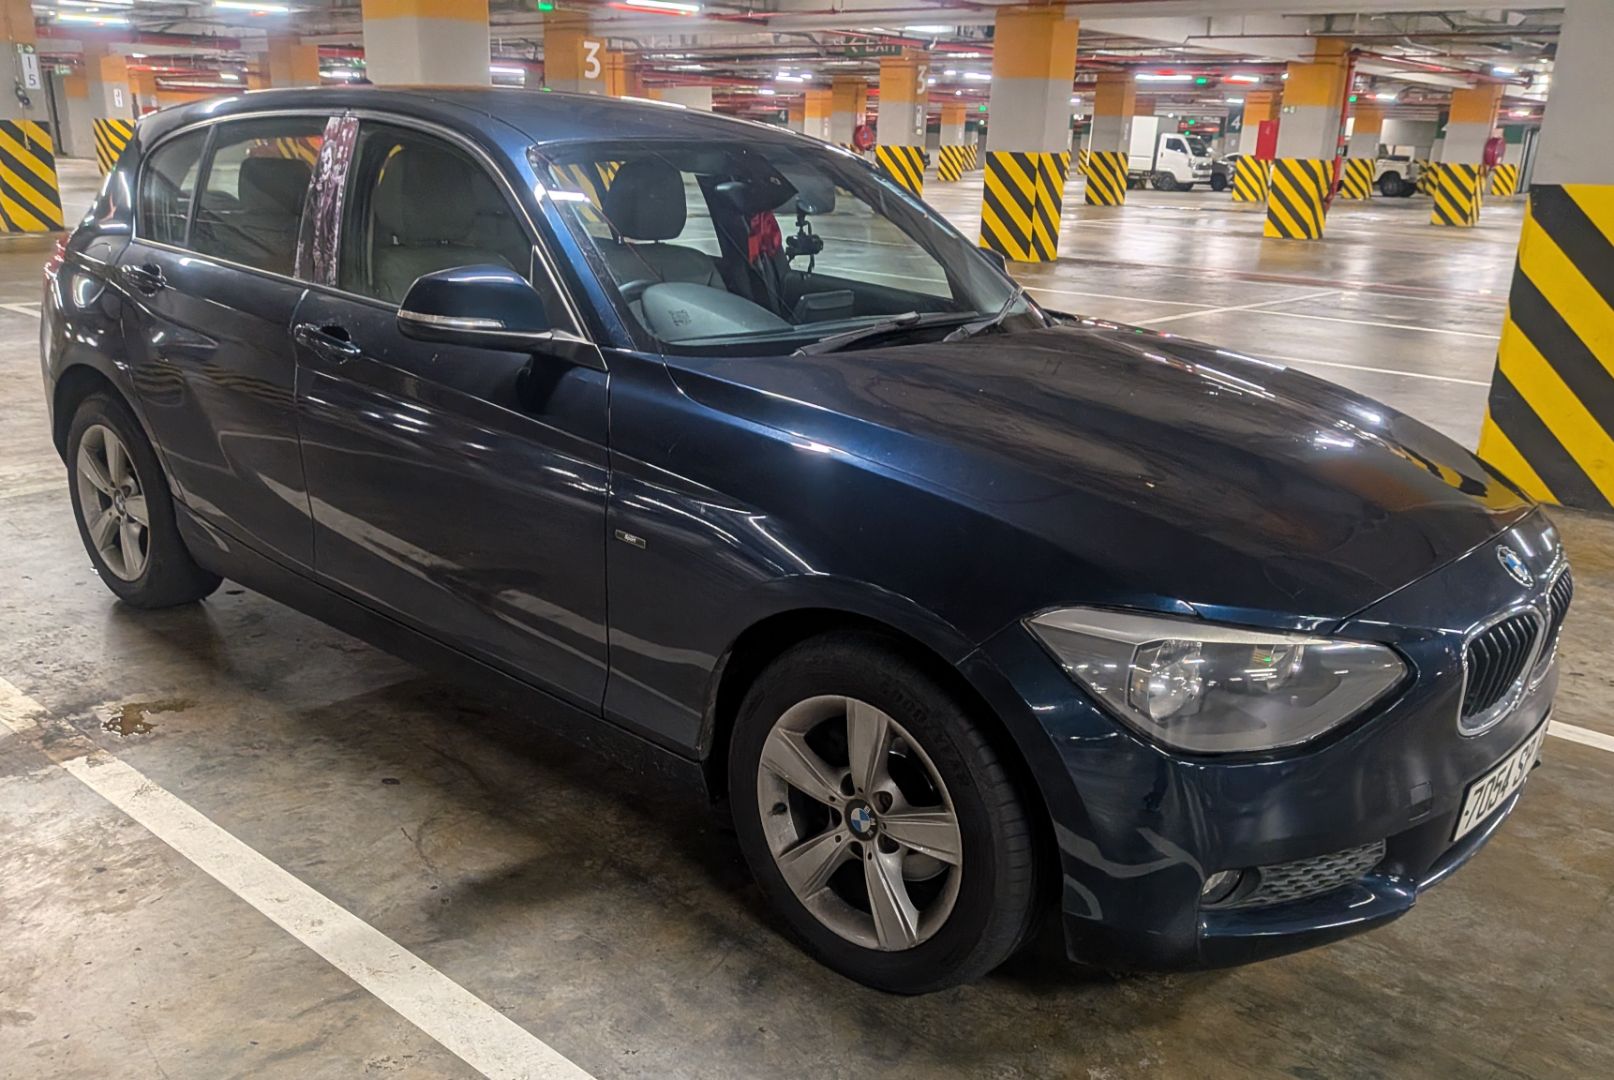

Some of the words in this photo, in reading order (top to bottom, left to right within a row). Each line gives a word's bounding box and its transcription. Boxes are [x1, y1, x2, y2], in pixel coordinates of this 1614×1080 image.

[583, 41, 600, 79] 3
[916, 65, 927, 95] 3
[1231, 115, 1241, 130] 4
[1465, 757, 1516, 830] 7054
